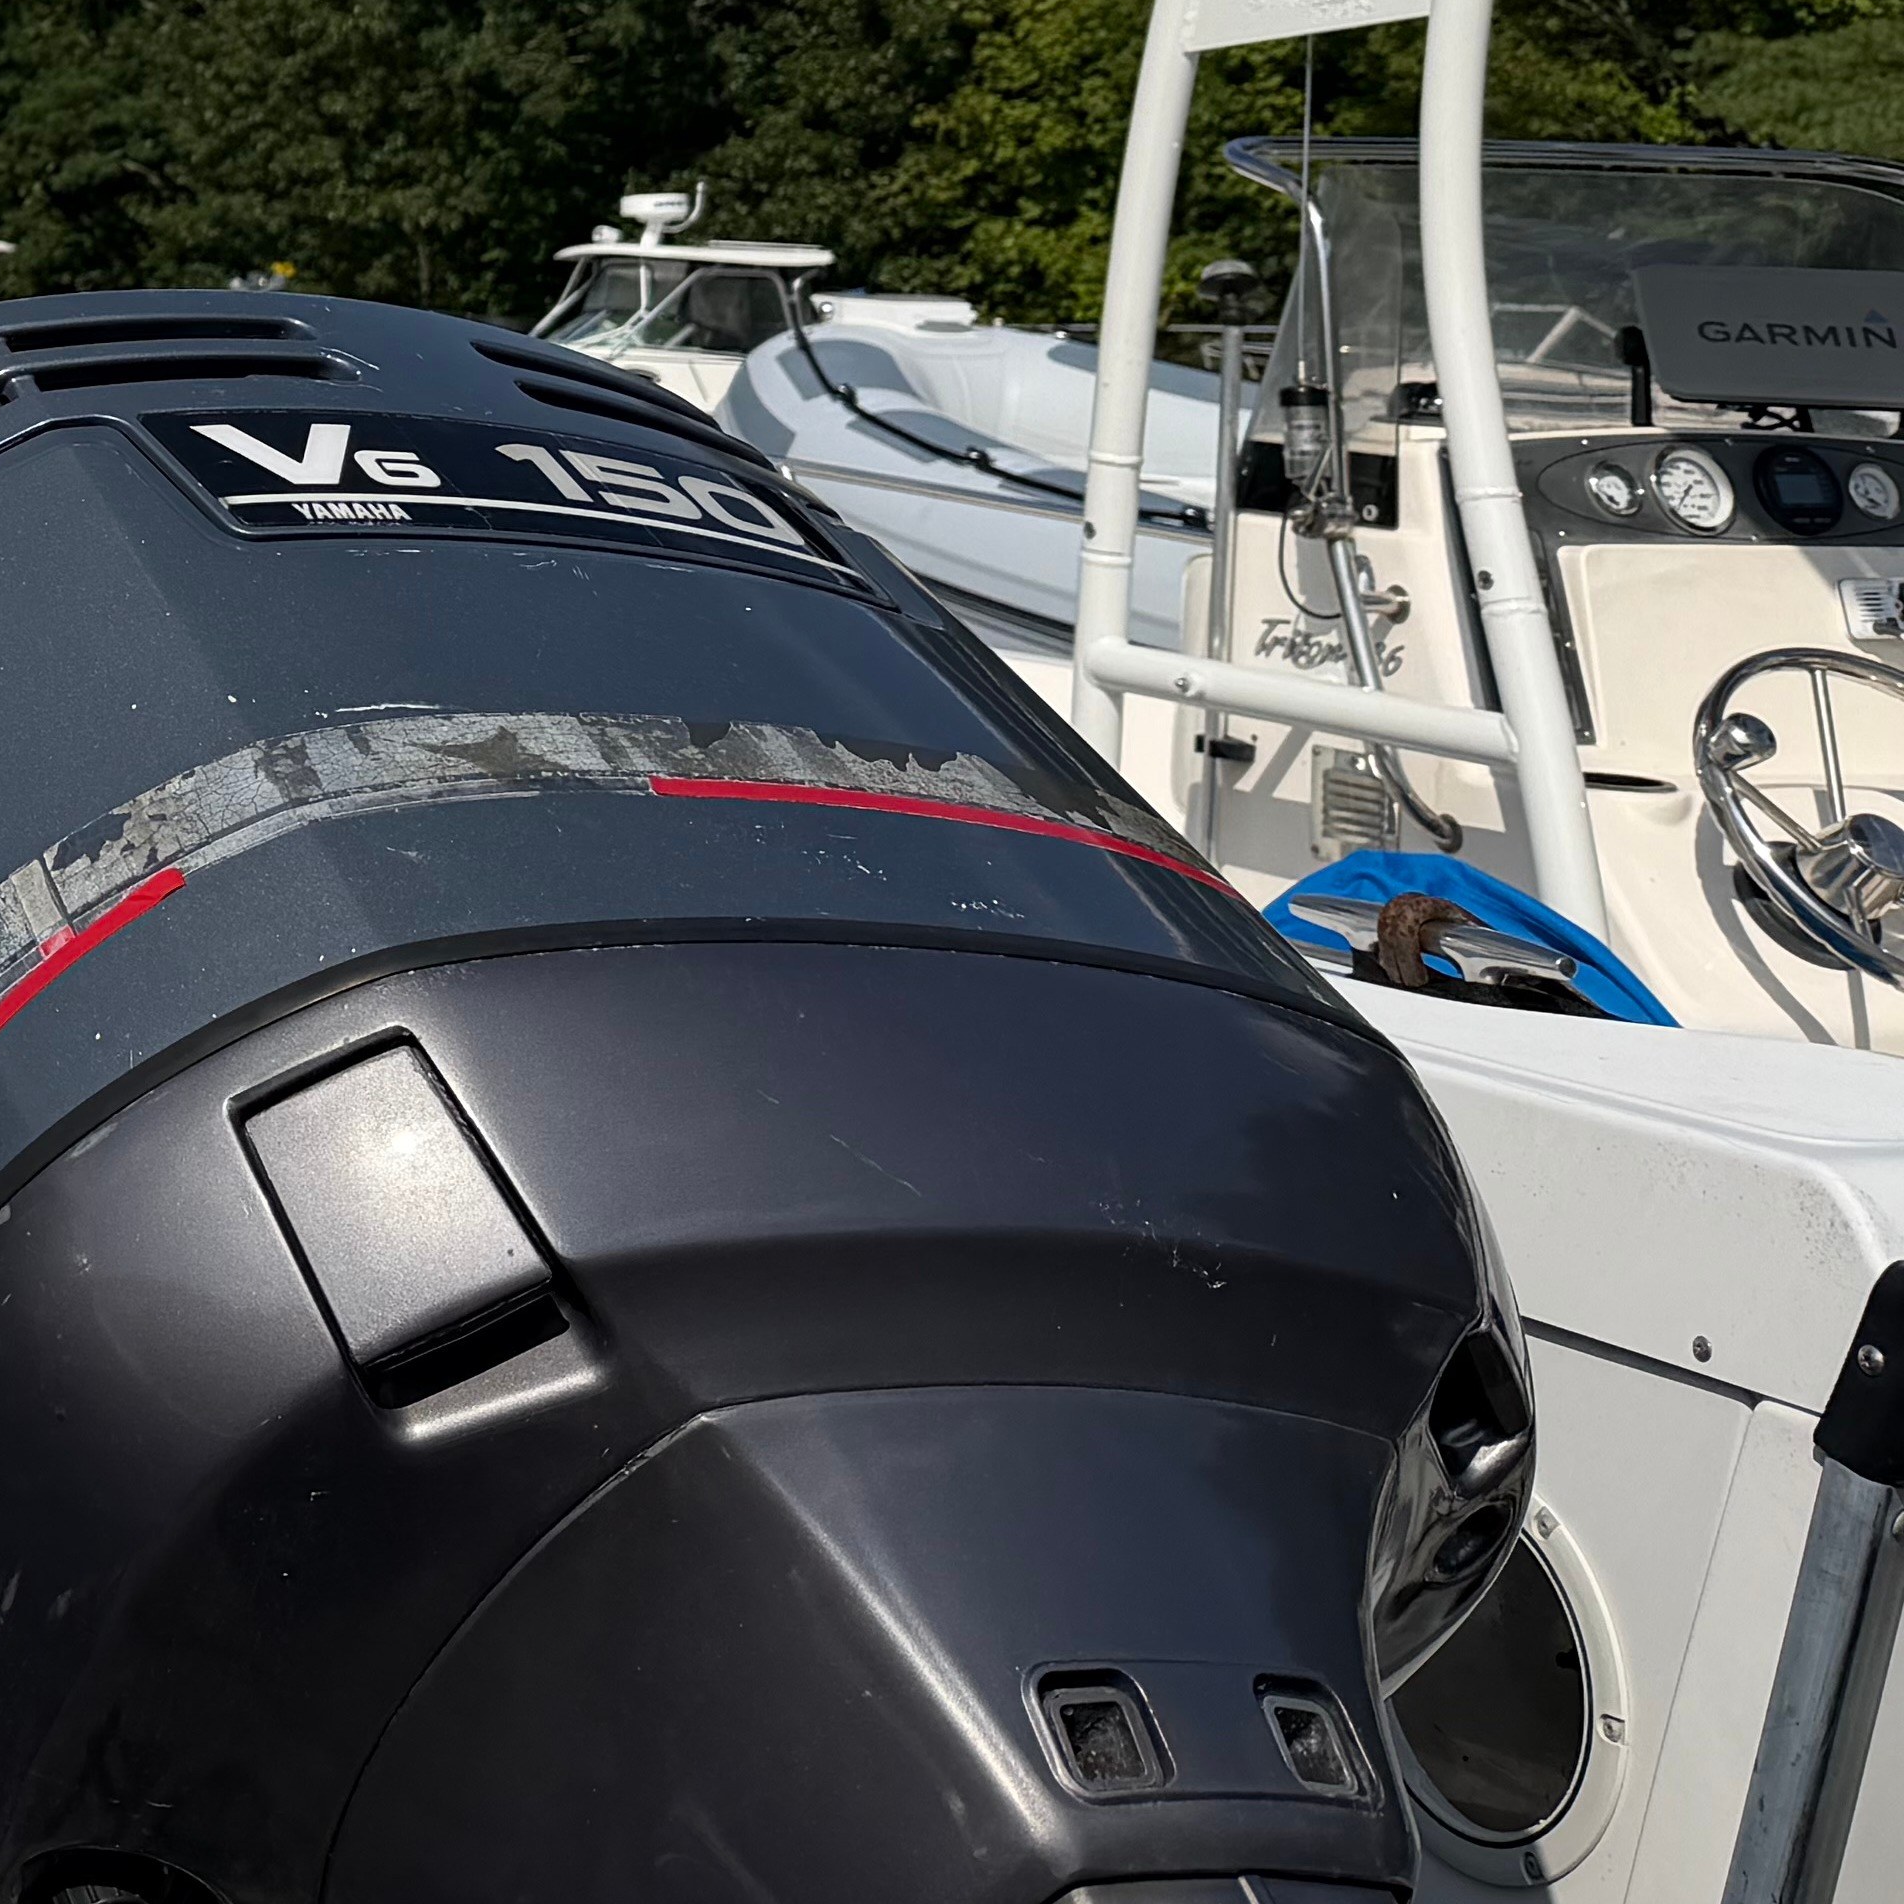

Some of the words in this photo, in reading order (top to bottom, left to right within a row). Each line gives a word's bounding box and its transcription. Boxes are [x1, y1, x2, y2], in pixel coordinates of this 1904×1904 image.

[1697, 321, 1897, 348] GARMIN
[190, 424, 442, 487] V6
[496, 443, 805, 547] 150
[292, 503, 413, 521] YAMAHA
